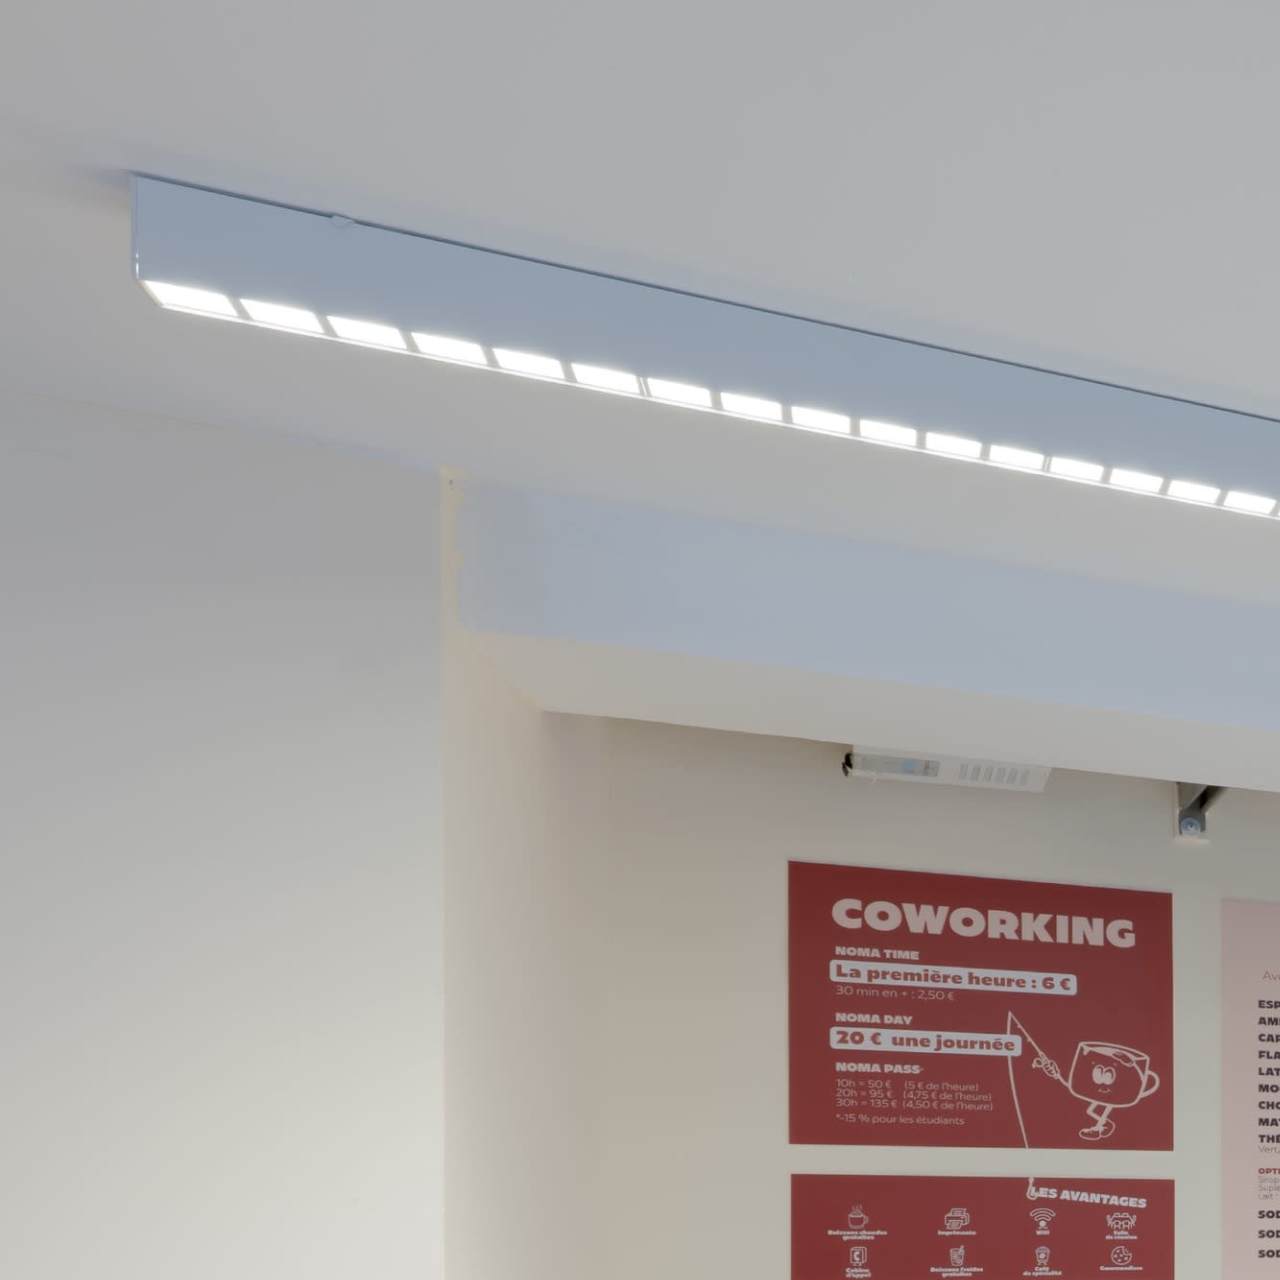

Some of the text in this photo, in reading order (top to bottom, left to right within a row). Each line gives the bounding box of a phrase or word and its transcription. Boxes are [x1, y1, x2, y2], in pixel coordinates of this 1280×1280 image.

[832, 898, 1135, 947] COWORKING
[835, 946, 919, 960] NOMA TIME
[836, 964, 860, 979] La
[867, 966, 962, 985] première
[968, 972, 1026, 988] heure
[1042, 976, 1055, 990] 6
[1059, 977, 1071, 991] €
[836, 986, 853, 997] 30
[857, 988, 879, 998] min
[882, 990, 898, 998] en
[835, 1012, 912, 1025] NOMA DAY
[836, 1031, 1015, 1051] 20 € une journée
[835, 1062, 880, 1073] NOMA
[1031, 1187, 1147, 1208] LES AVANTAGES
